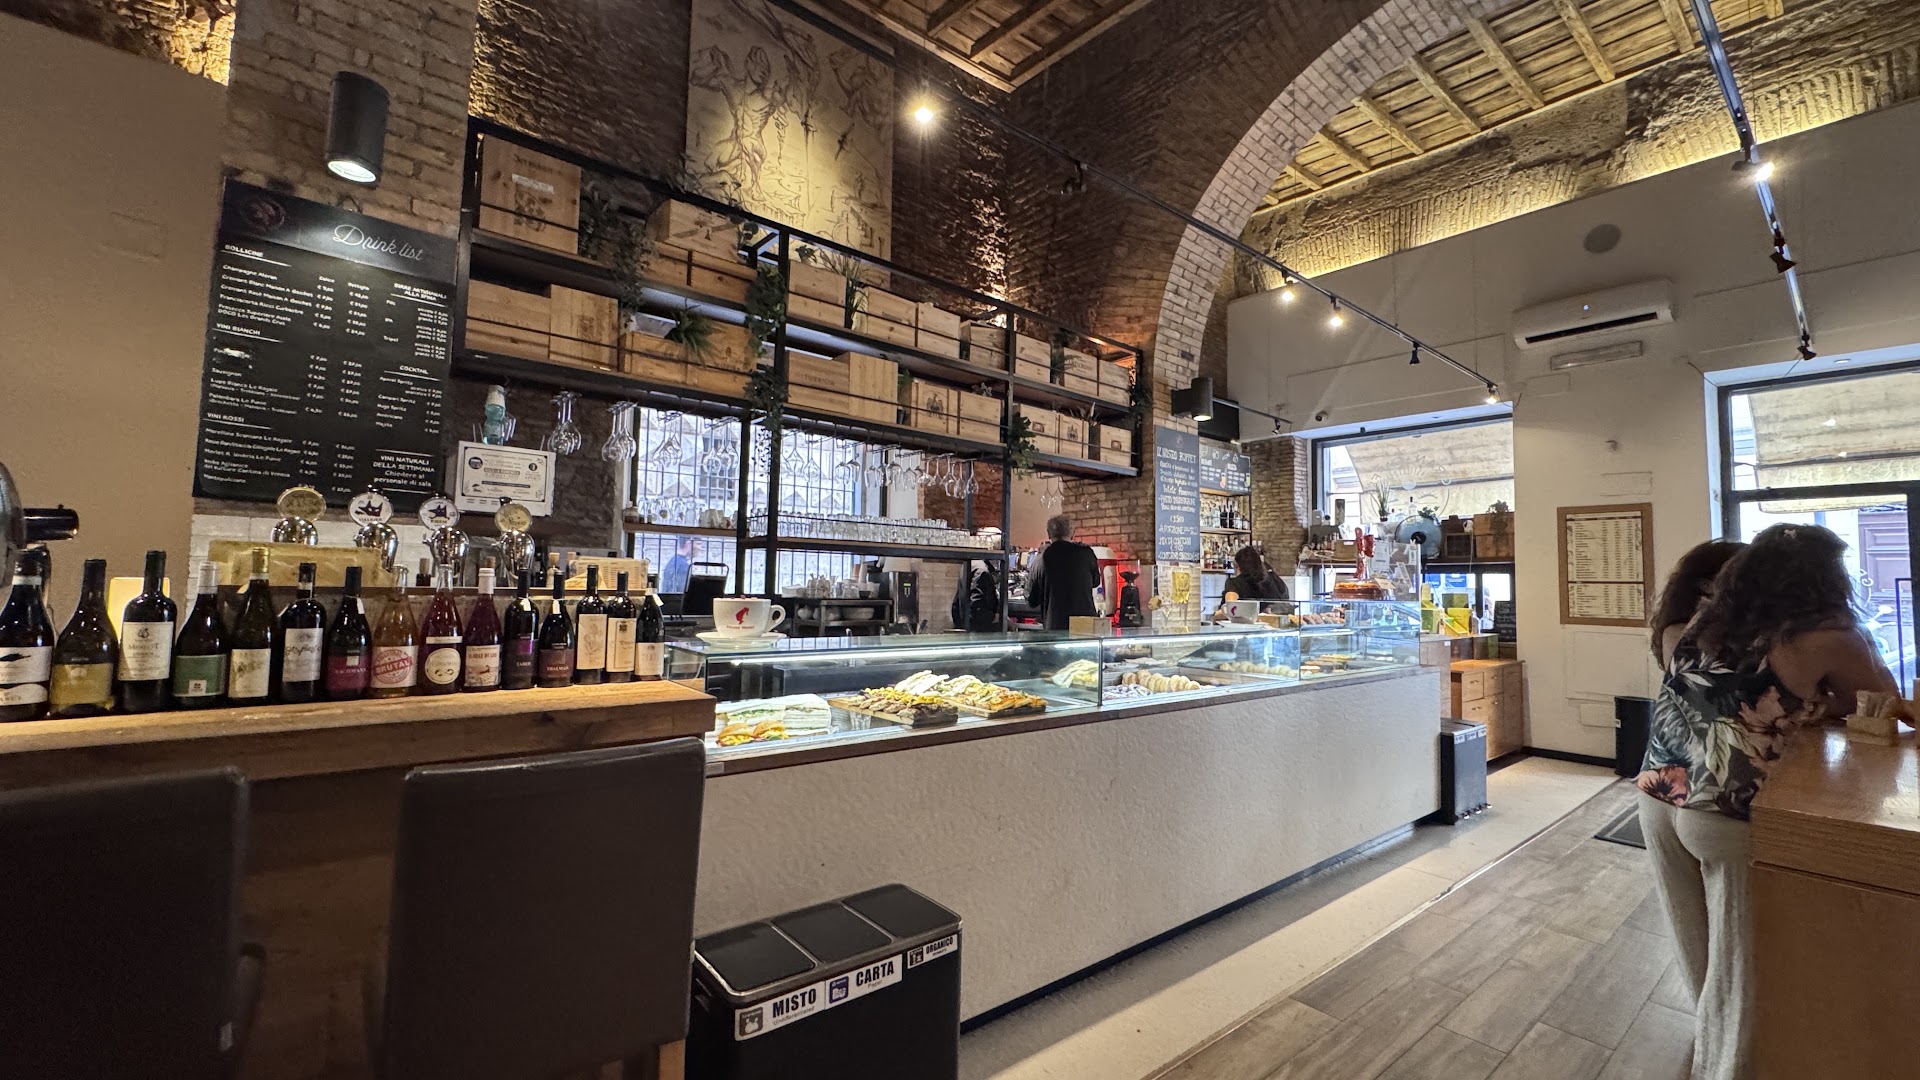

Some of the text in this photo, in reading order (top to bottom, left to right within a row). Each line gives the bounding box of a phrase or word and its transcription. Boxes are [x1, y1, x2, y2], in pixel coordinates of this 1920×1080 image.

[332, 224, 423, 261] Drink list
[225, 245, 263, 257] BOLLICINE
[223, 265, 257, 276] Champagne
[265, 283, 285, 291] Maison
[263, 293, 283, 301] Maison
[412, 287, 446, 299] ARTIGIANALI
[420, 293, 436, 301] SPINA
[220, 294, 258, 306] Franciacorta
[218, 303, 245, 313] Prosecco
[247, 309, 275, 318] Superiore
[232, 326, 260, 335] BIANCHI
[212, 367, 242, 377] Sauvignon
[399, 365, 428, 374] COCKTAIL
[227, 380, 248, 389] Bianco
[205, 428, 234, 436] Morellino
[236, 432, 263, 440] Scansano
[373, 461, 435, 472] DELLA SETTIMANA
[396, 457, 429, 465] NATURALI
[385, 470, 417, 478] Chiedere
[925, 936, 954, 955] ORGANICO
[856, 960, 895, 987] CARTA
[772, 988, 817, 1018] MISTO
